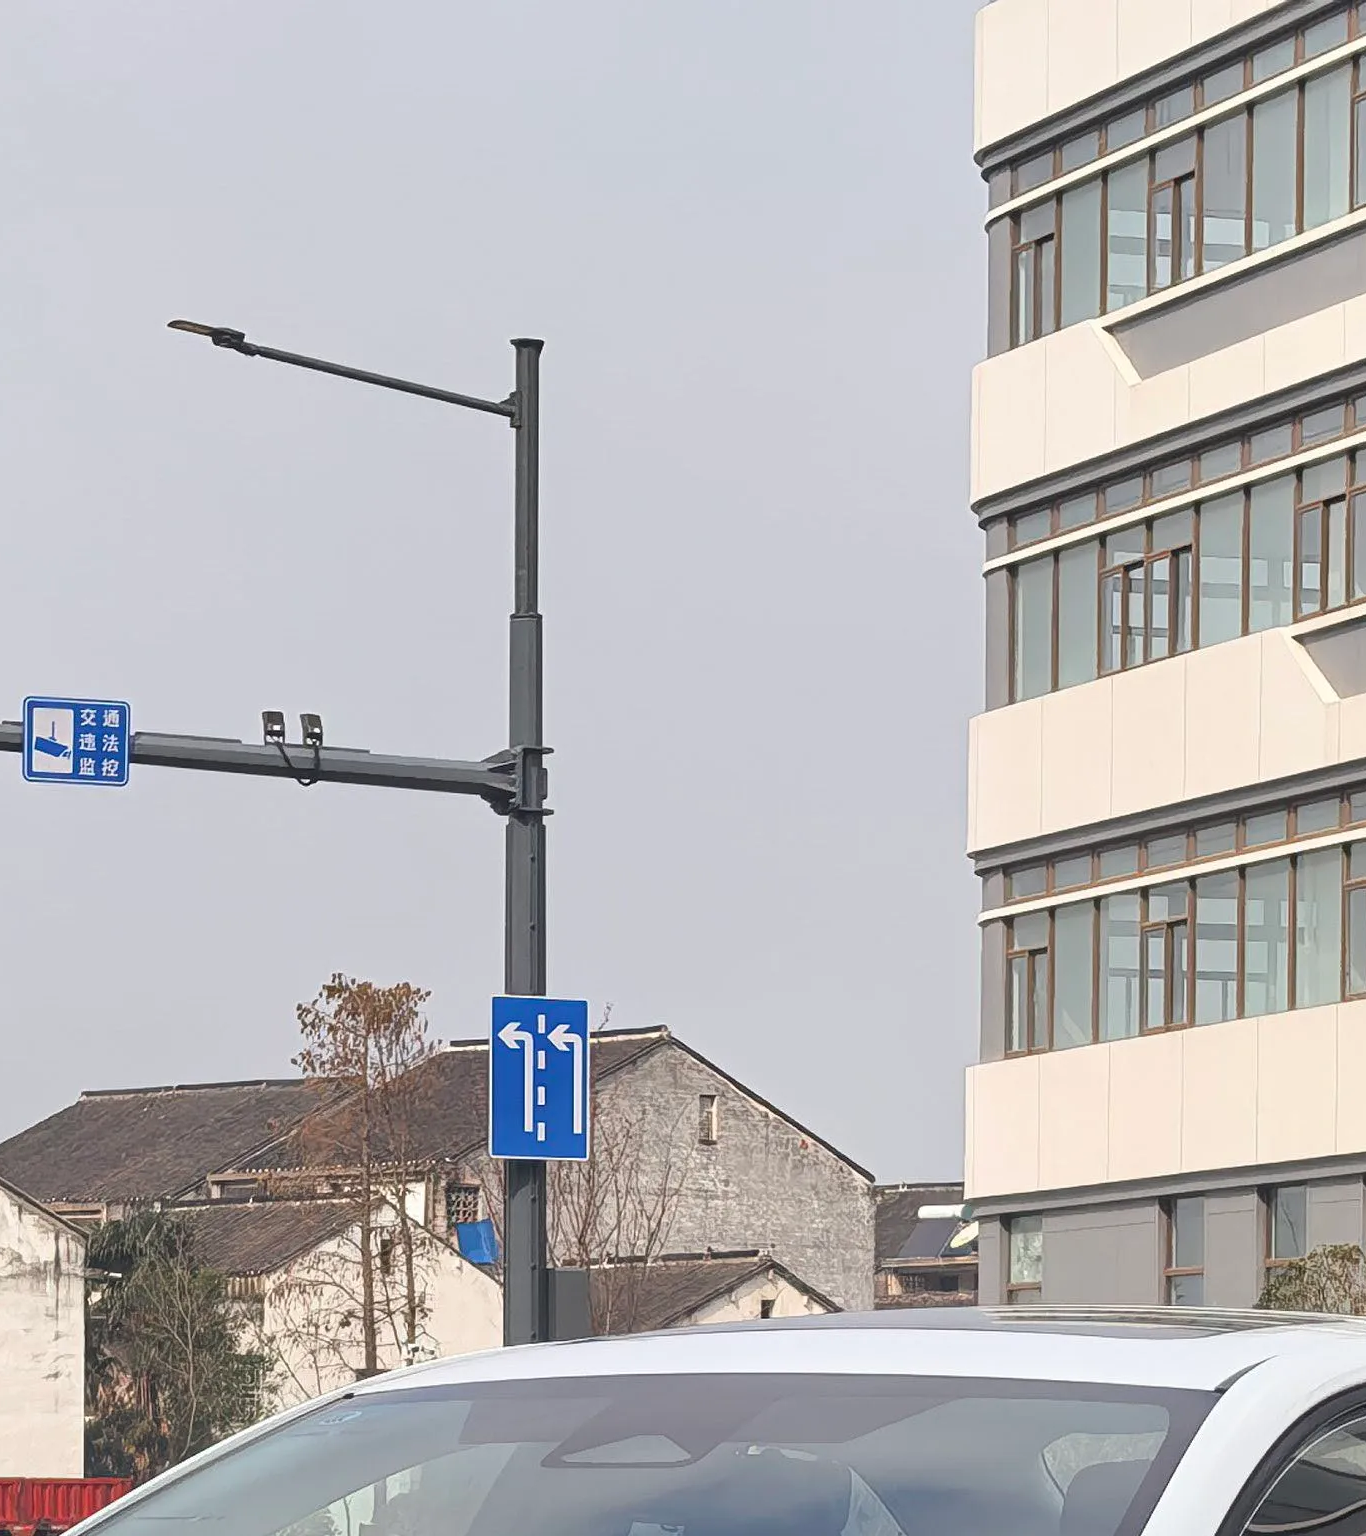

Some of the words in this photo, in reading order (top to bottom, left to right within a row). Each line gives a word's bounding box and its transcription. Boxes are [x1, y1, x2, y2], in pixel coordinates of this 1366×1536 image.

[80, 708, 120, 728] 交通
[79, 733, 119, 753] 违法
[78, 757, 119, 777] 监控
